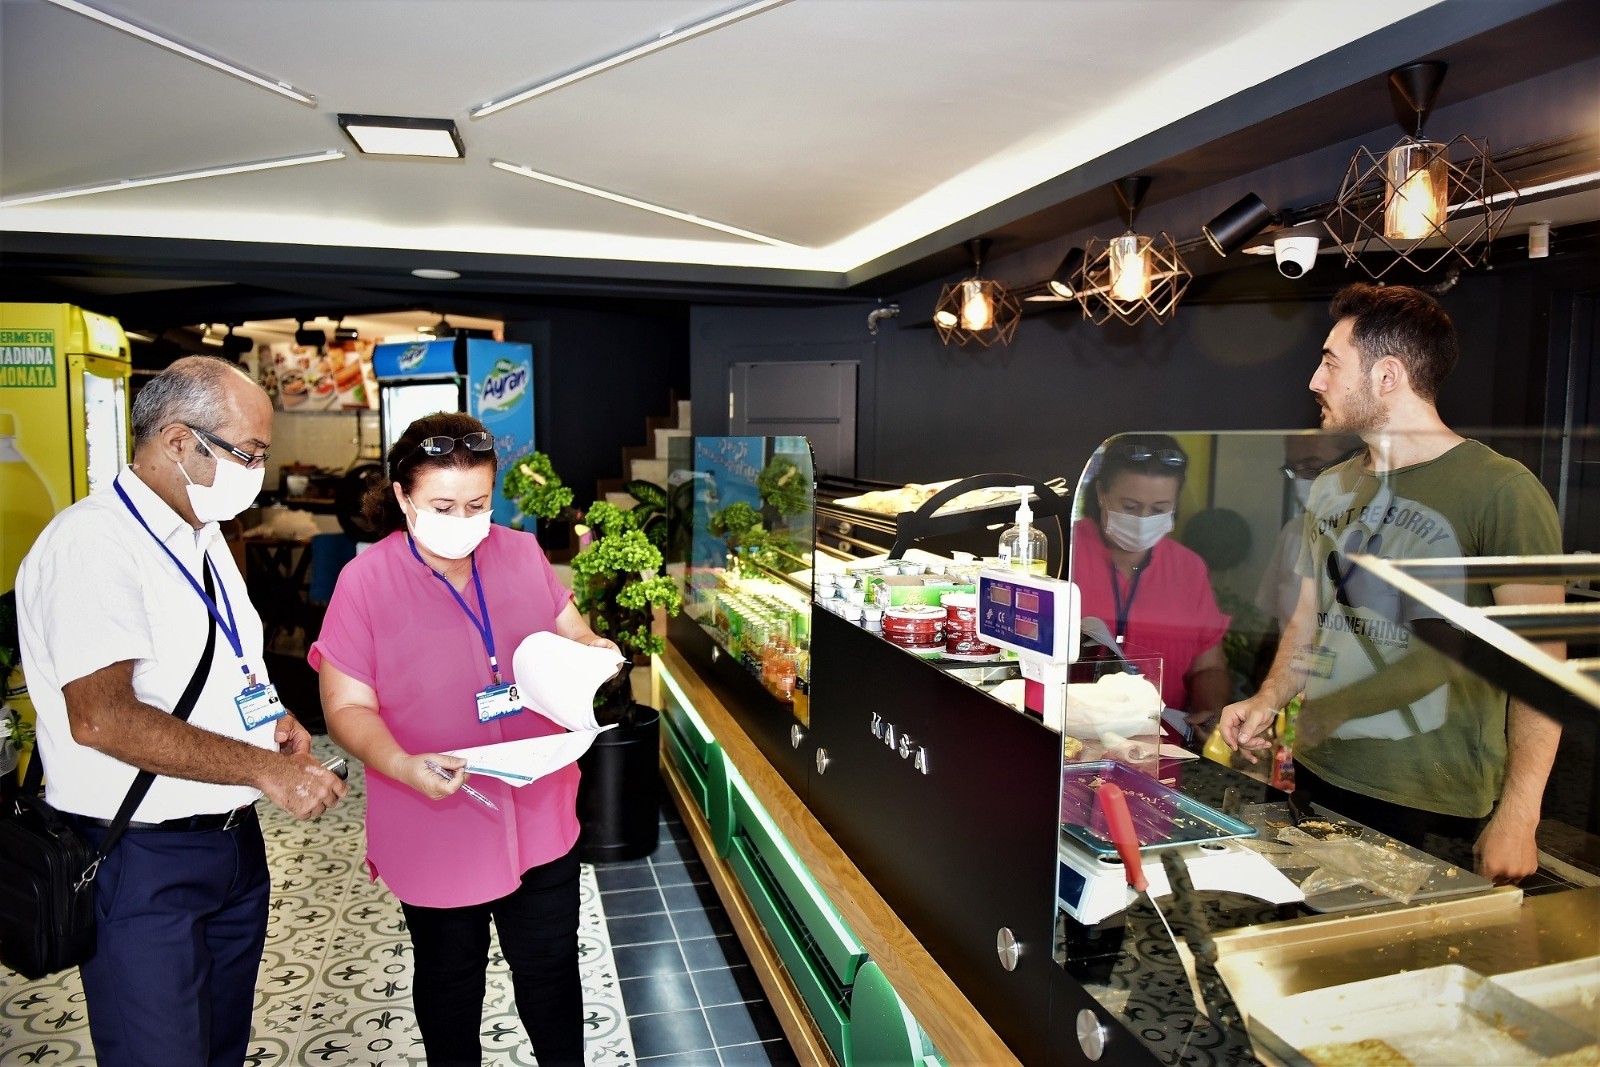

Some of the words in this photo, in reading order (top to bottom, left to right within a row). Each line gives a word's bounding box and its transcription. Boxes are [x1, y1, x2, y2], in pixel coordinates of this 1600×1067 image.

[1, 331, 52, 343] ERMEYEN
[483, 370, 525, 400] Ayran
[1311, 508, 1355, 543] DON'T
[1360, 505, 1383, 523] BE
[1383, 505, 1449, 545] SORRY
[1328, 613, 1409, 641] SOMETHING
[870, 711, 927, 775] KASA
